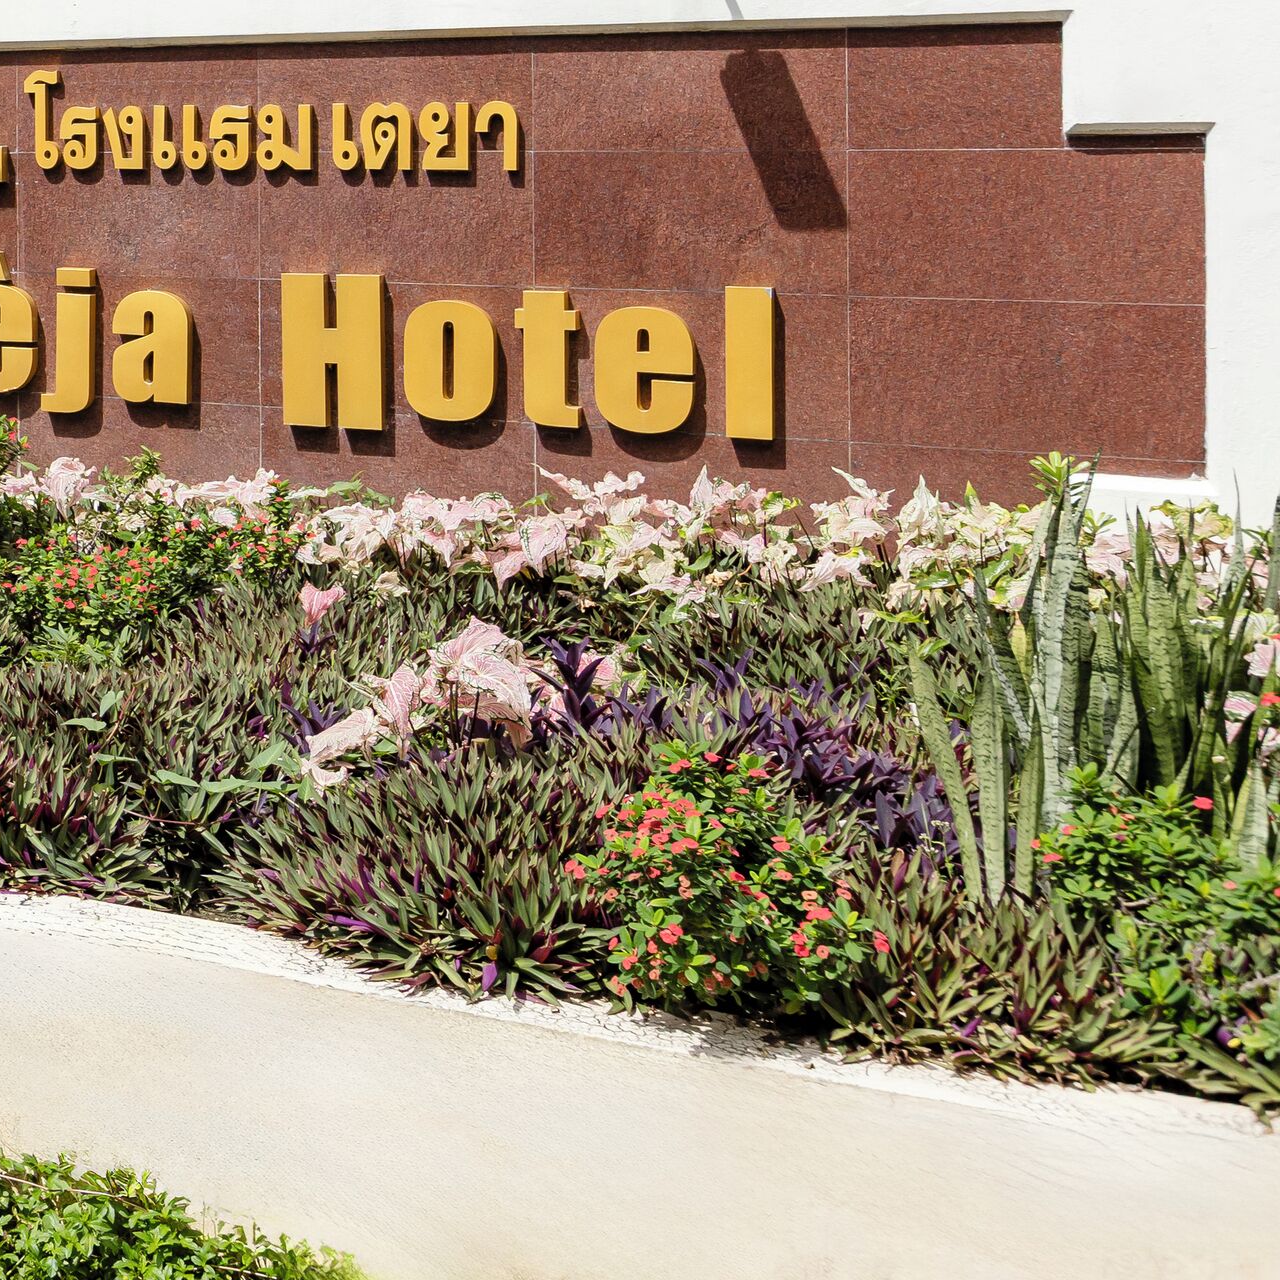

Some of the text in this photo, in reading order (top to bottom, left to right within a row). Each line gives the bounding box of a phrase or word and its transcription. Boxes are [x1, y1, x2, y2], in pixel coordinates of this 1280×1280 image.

[24, 70, 519, 172] โรงแรม เตยา
[281, 272, 775, 441] Hotel
